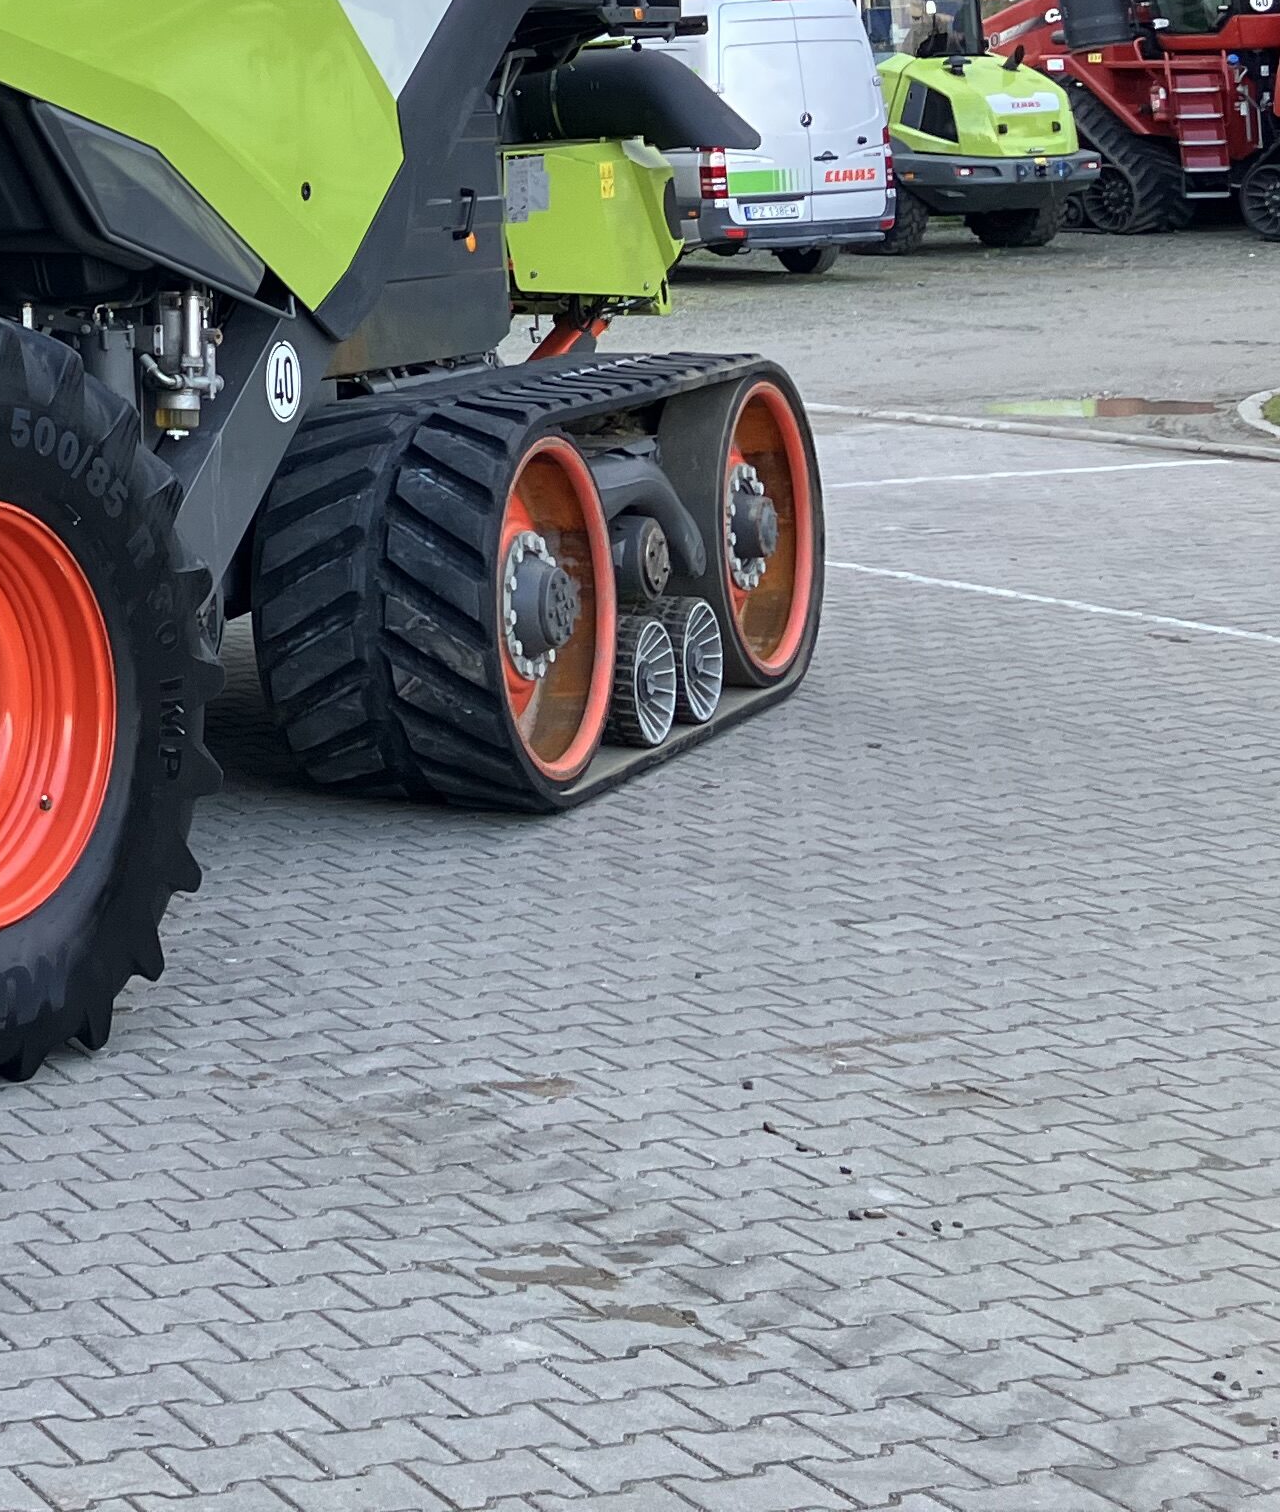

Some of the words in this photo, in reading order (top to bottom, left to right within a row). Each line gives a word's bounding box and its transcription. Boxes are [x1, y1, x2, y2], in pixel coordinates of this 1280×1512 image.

[824, 168, 876, 183] CLAAS
[274, 355, 294, 406] 40
[10, 407, 129, 518] 500/85
